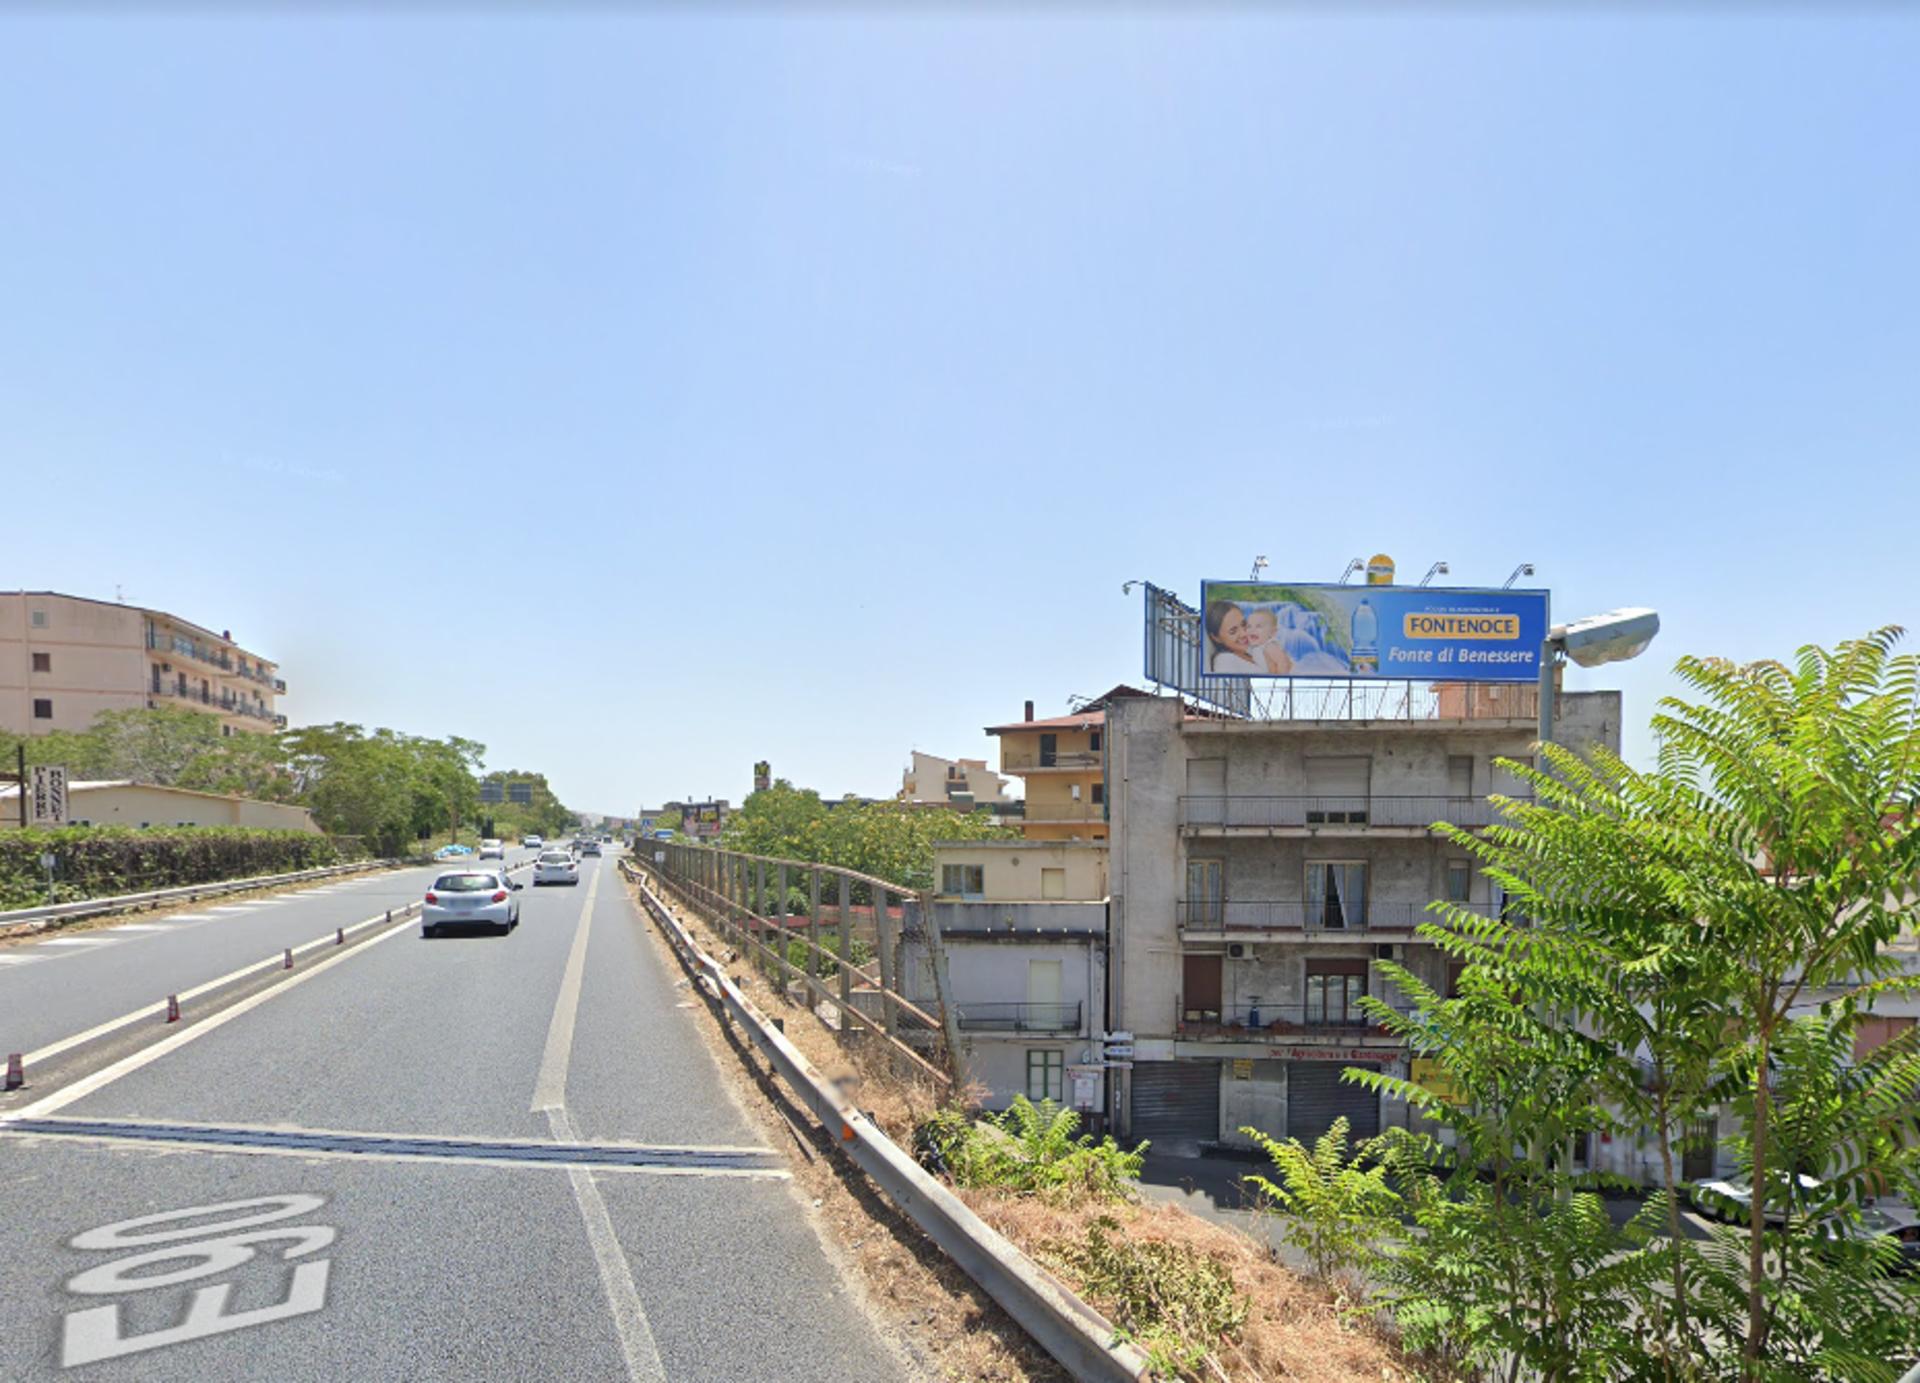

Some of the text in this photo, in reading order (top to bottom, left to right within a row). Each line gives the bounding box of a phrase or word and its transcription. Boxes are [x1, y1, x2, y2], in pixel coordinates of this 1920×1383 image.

[1410, 617, 1514, 634] FONTENOCE
[1388, 646, 1534, 663] Fonte di Benessere
[62, 1194, 335, 1368] E90
